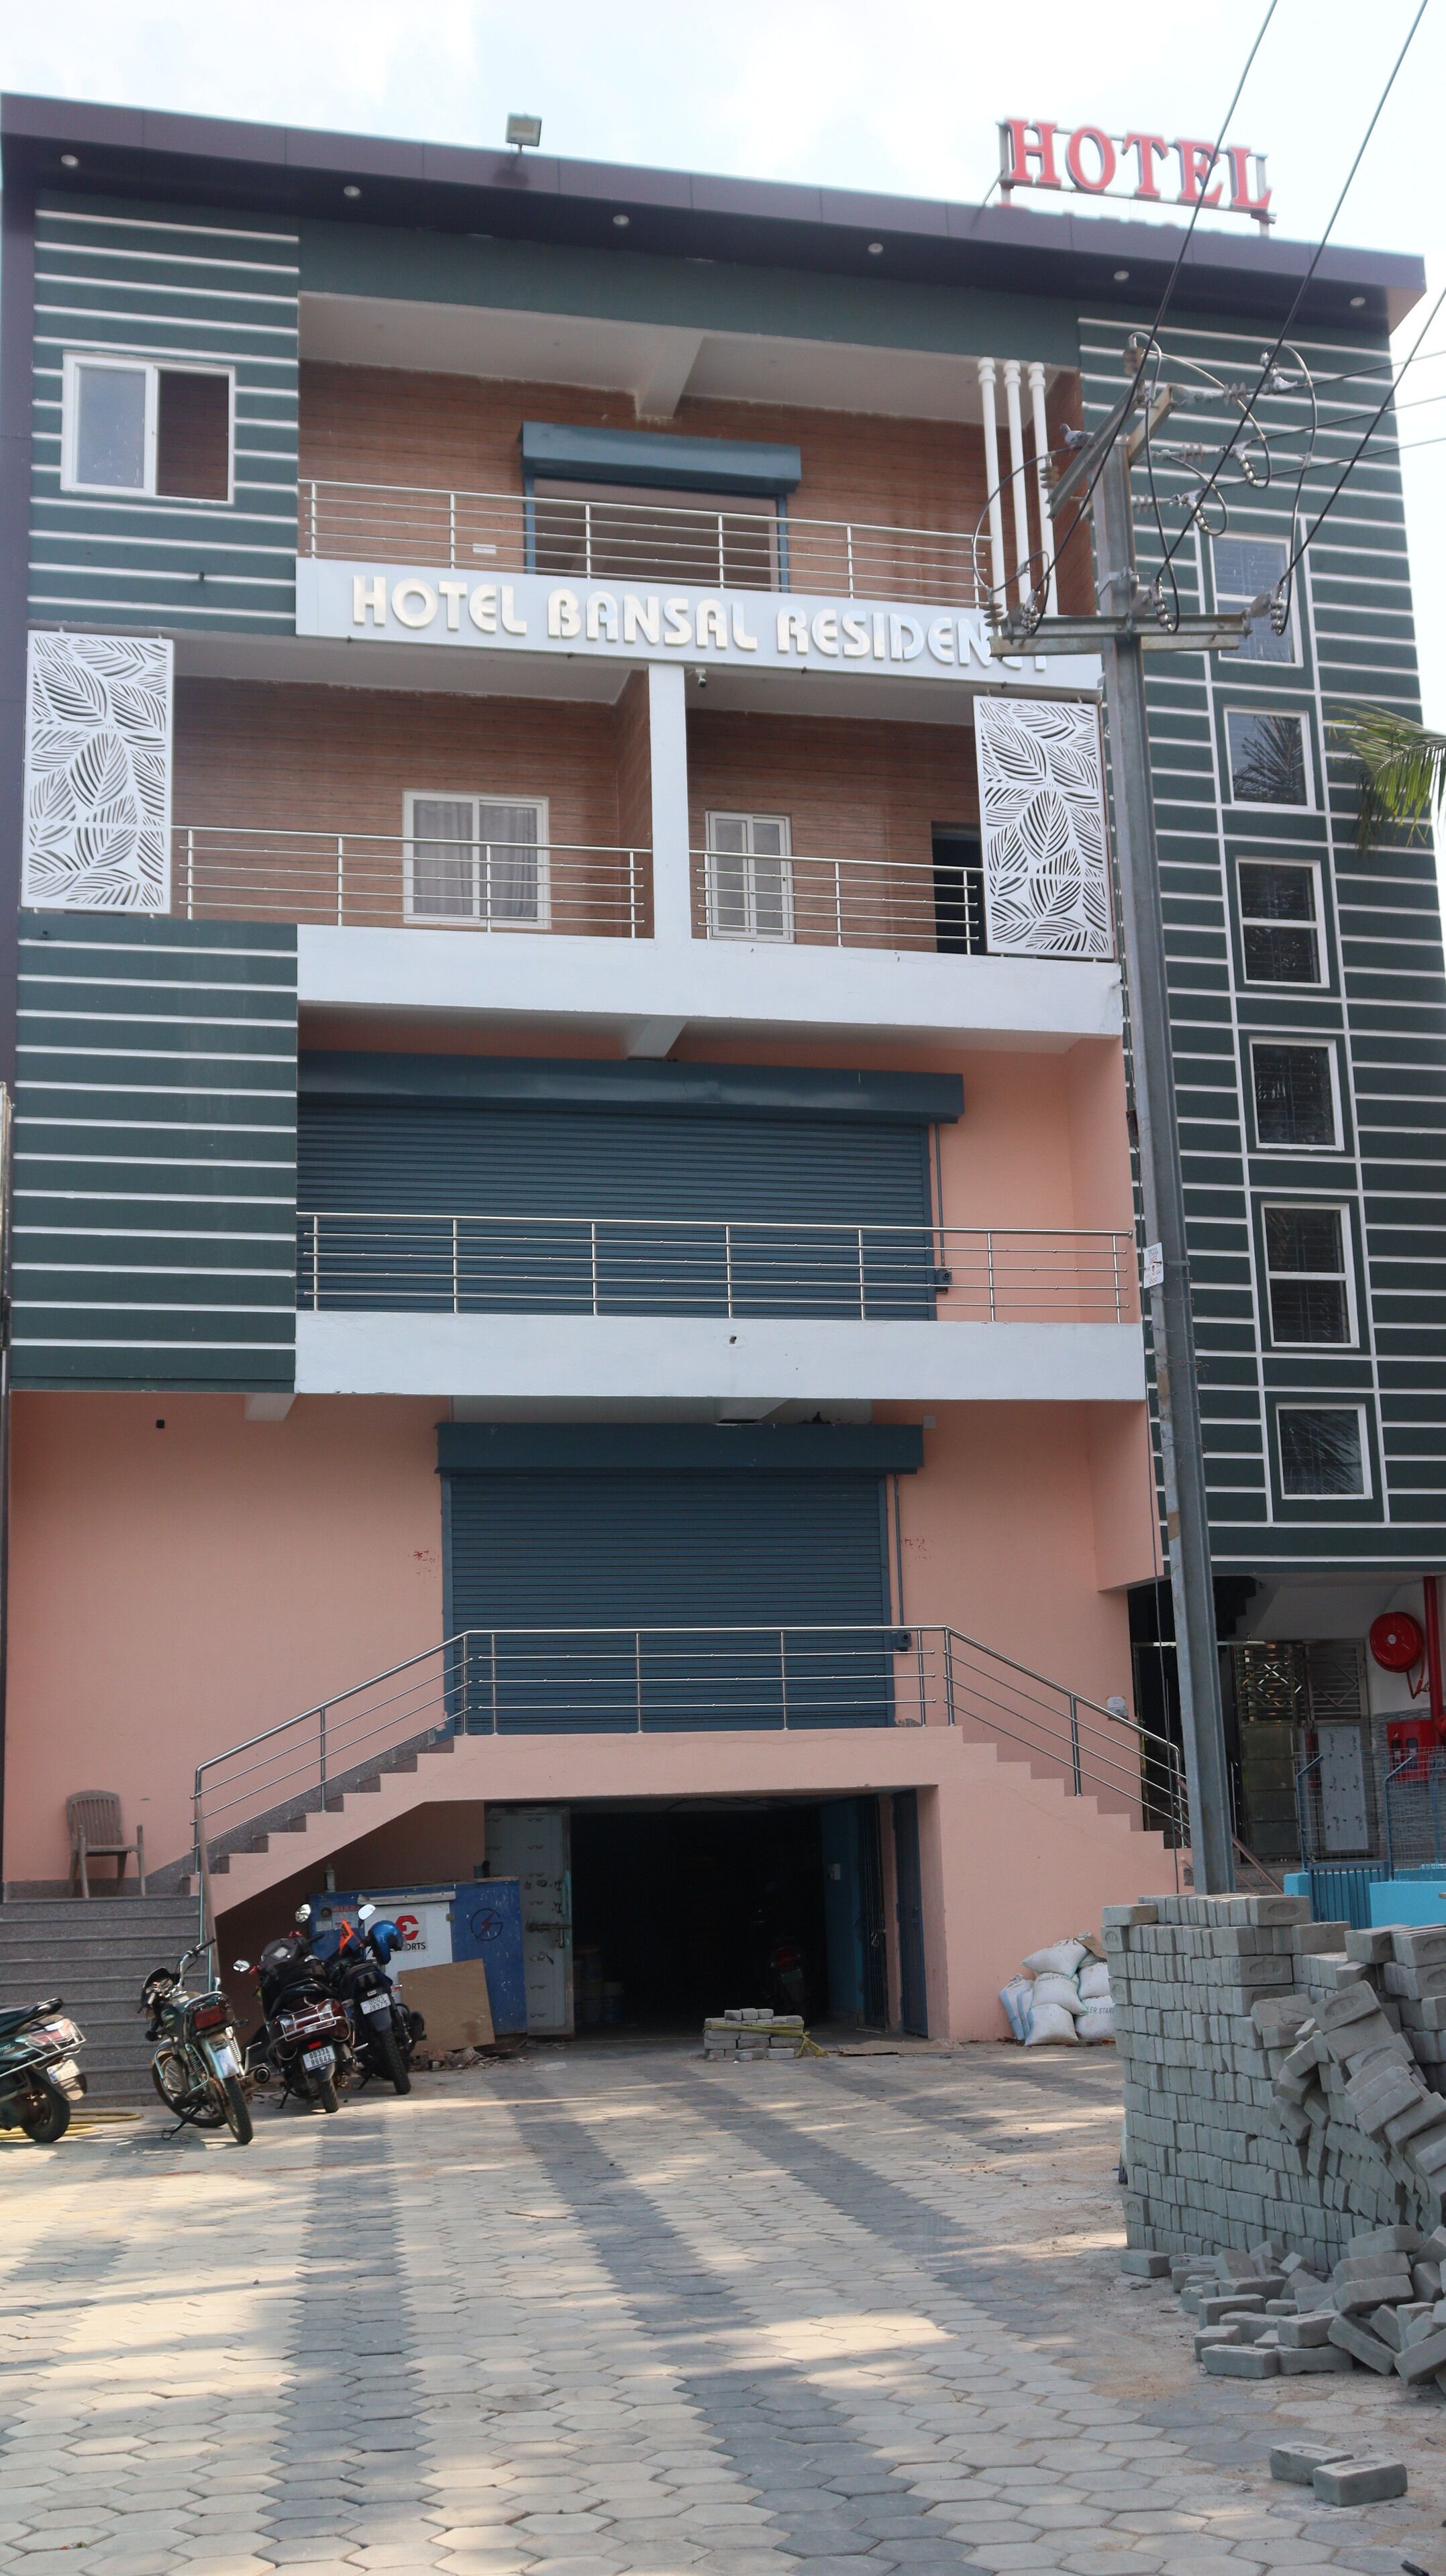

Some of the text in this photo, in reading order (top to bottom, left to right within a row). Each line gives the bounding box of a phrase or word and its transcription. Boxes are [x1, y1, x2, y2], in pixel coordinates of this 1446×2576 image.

[1004, 115, 1273, 209] HOTEL
[353, 575, 1047, 672] HOTEL BANSAL RESIDEN
